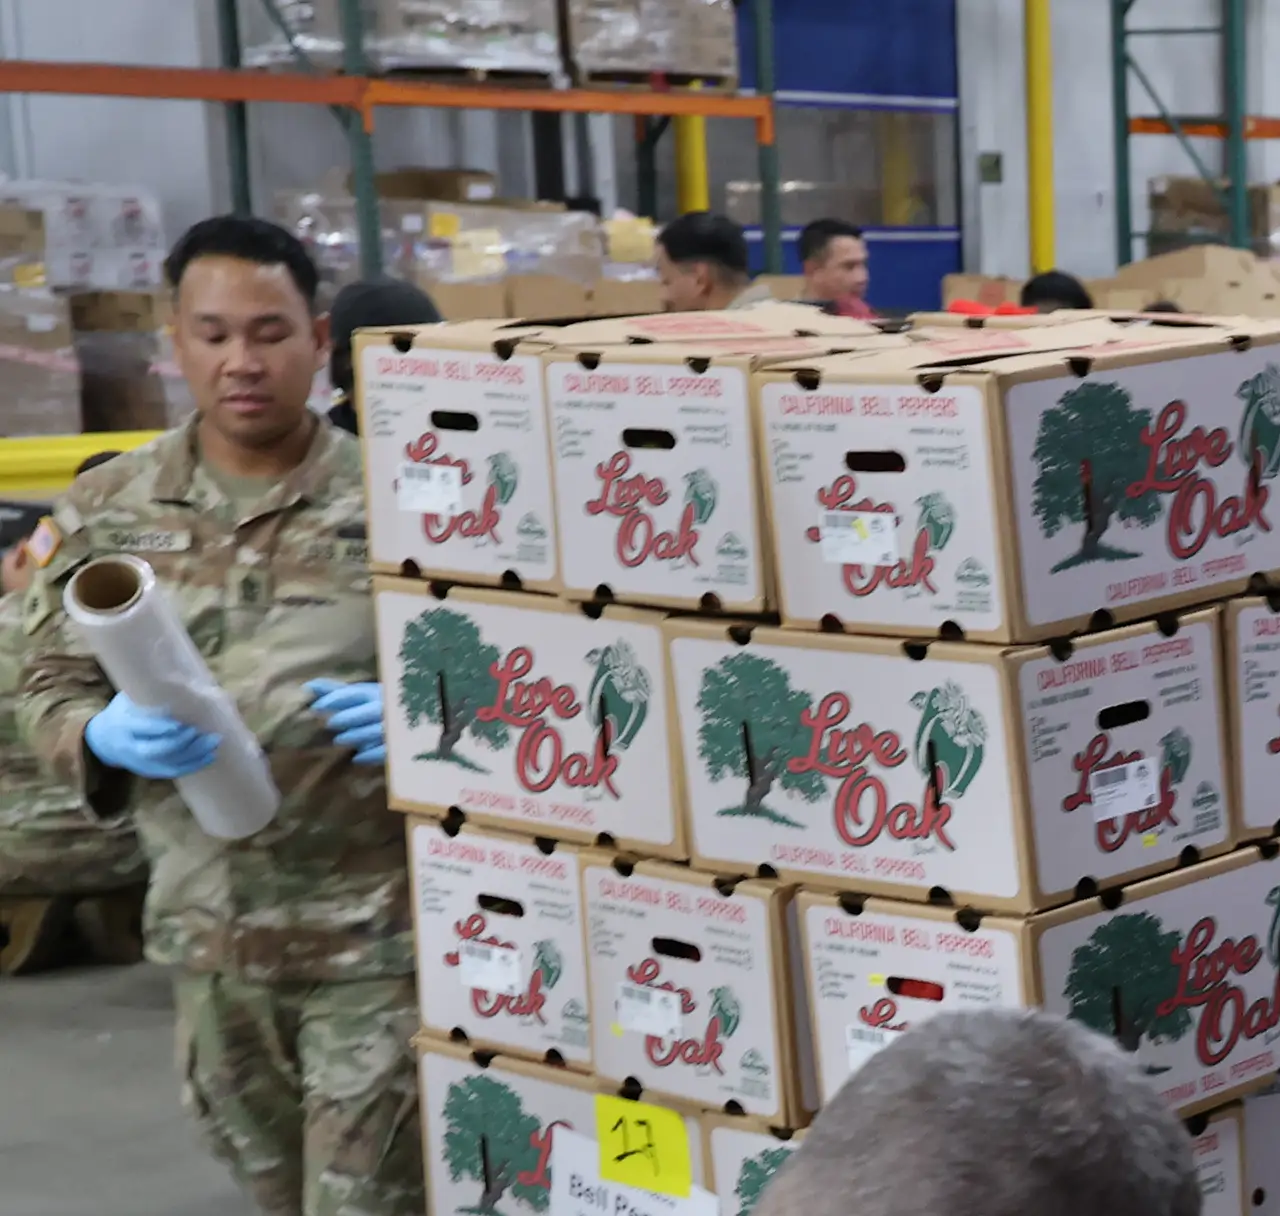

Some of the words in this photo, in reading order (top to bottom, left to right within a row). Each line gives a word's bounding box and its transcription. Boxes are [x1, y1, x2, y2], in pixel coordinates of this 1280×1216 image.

[587, 450, 669, 516] Live
[1125, 400, 1235, 498] Live
[617, 502, 702, 567] Oak
[1167, 448, 1270, 560] Oak
[476, 647, 582, 727] Live
[516, 715, 621, 799] Oak
[788, 691, 909, 778] Live
[833, 763, 955, 851] Oak
[1156, 916, 1263, 1016] Live
[569, 1173, 610, 1211] Bell
